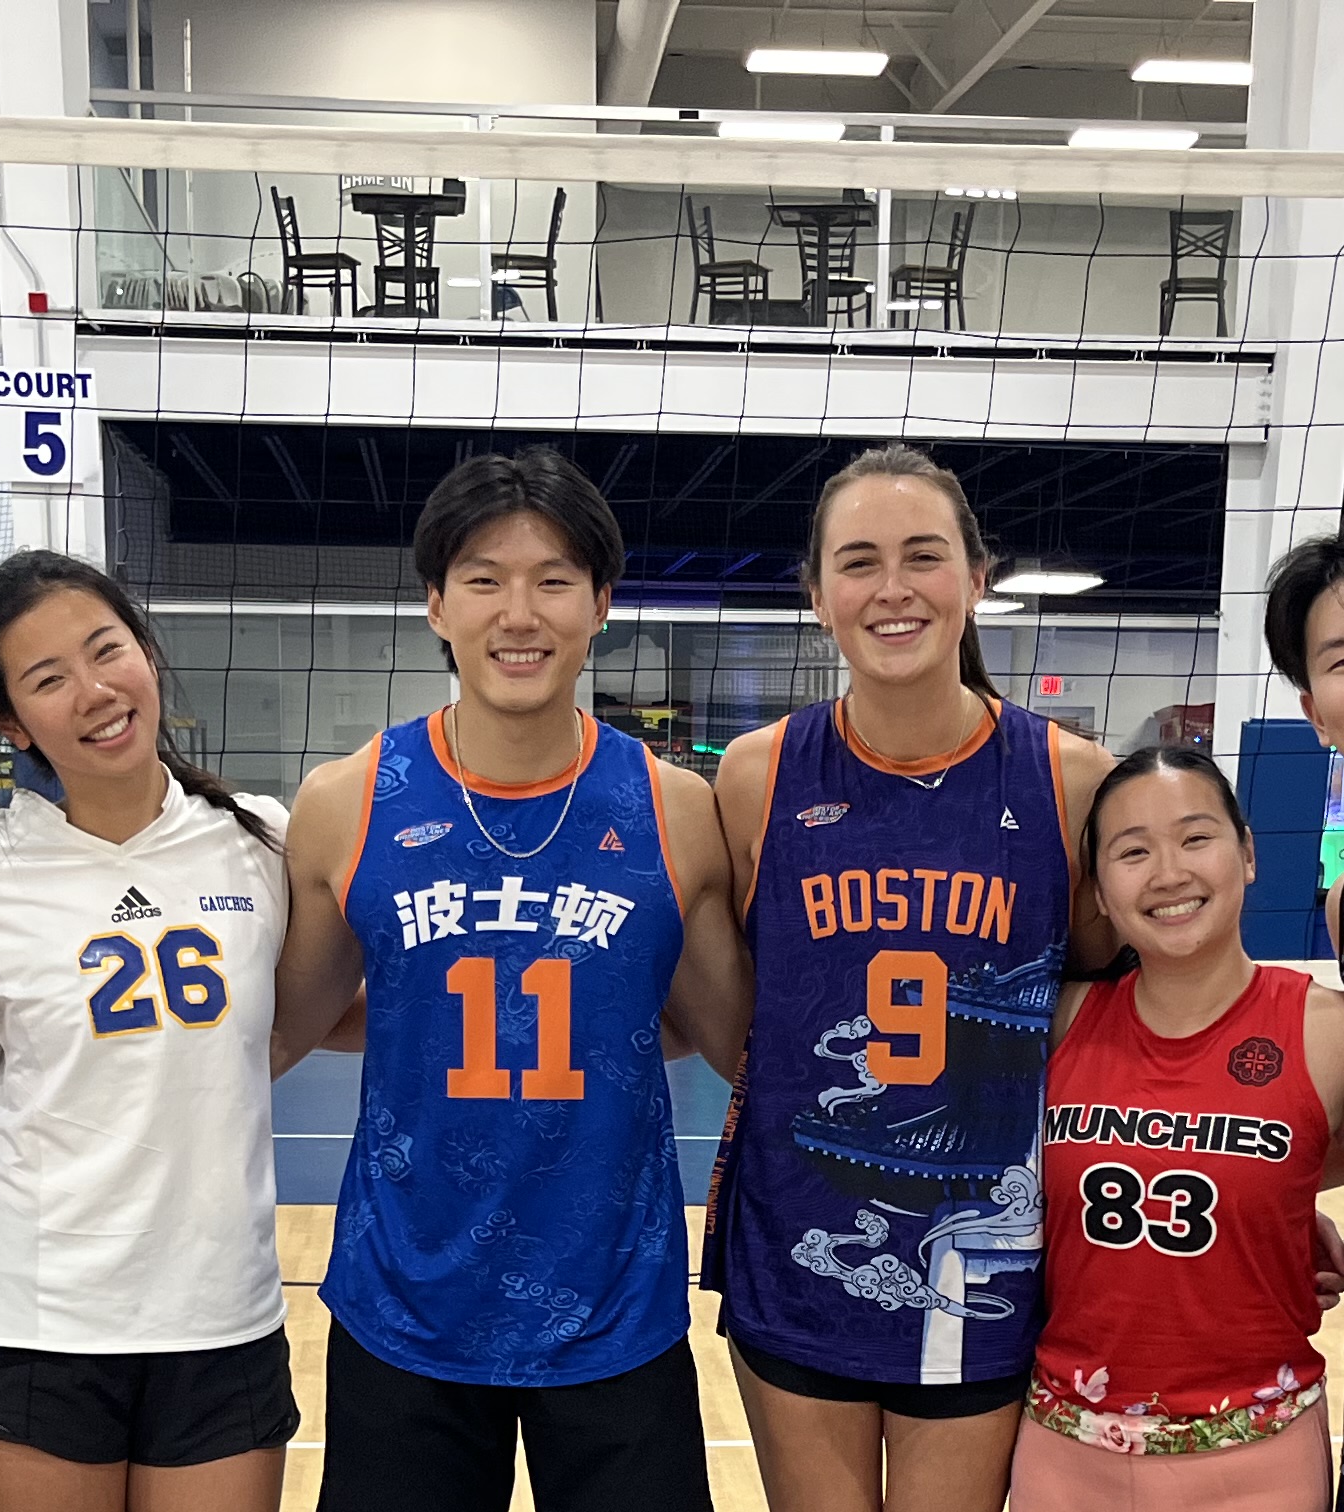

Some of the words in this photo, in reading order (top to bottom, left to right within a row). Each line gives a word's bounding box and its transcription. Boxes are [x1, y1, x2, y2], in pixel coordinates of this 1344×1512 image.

[23, 411, 66, 476] 5
[111, 905, 162, 923] adidas
[199, 895, 254, 912] GAUCHOS
[393, 876, 635, 950] 波士顿
[801, 868, 1017, 944] BOSTON
[78, 924, 231, 1039] 26
[867, 950, 948, 1085] 9
[446, 957, 584, 1100] 11
[1043, 1104, 1292, 1162] MUNCHIES
[1079, 1162, 1218, 1257] 83
